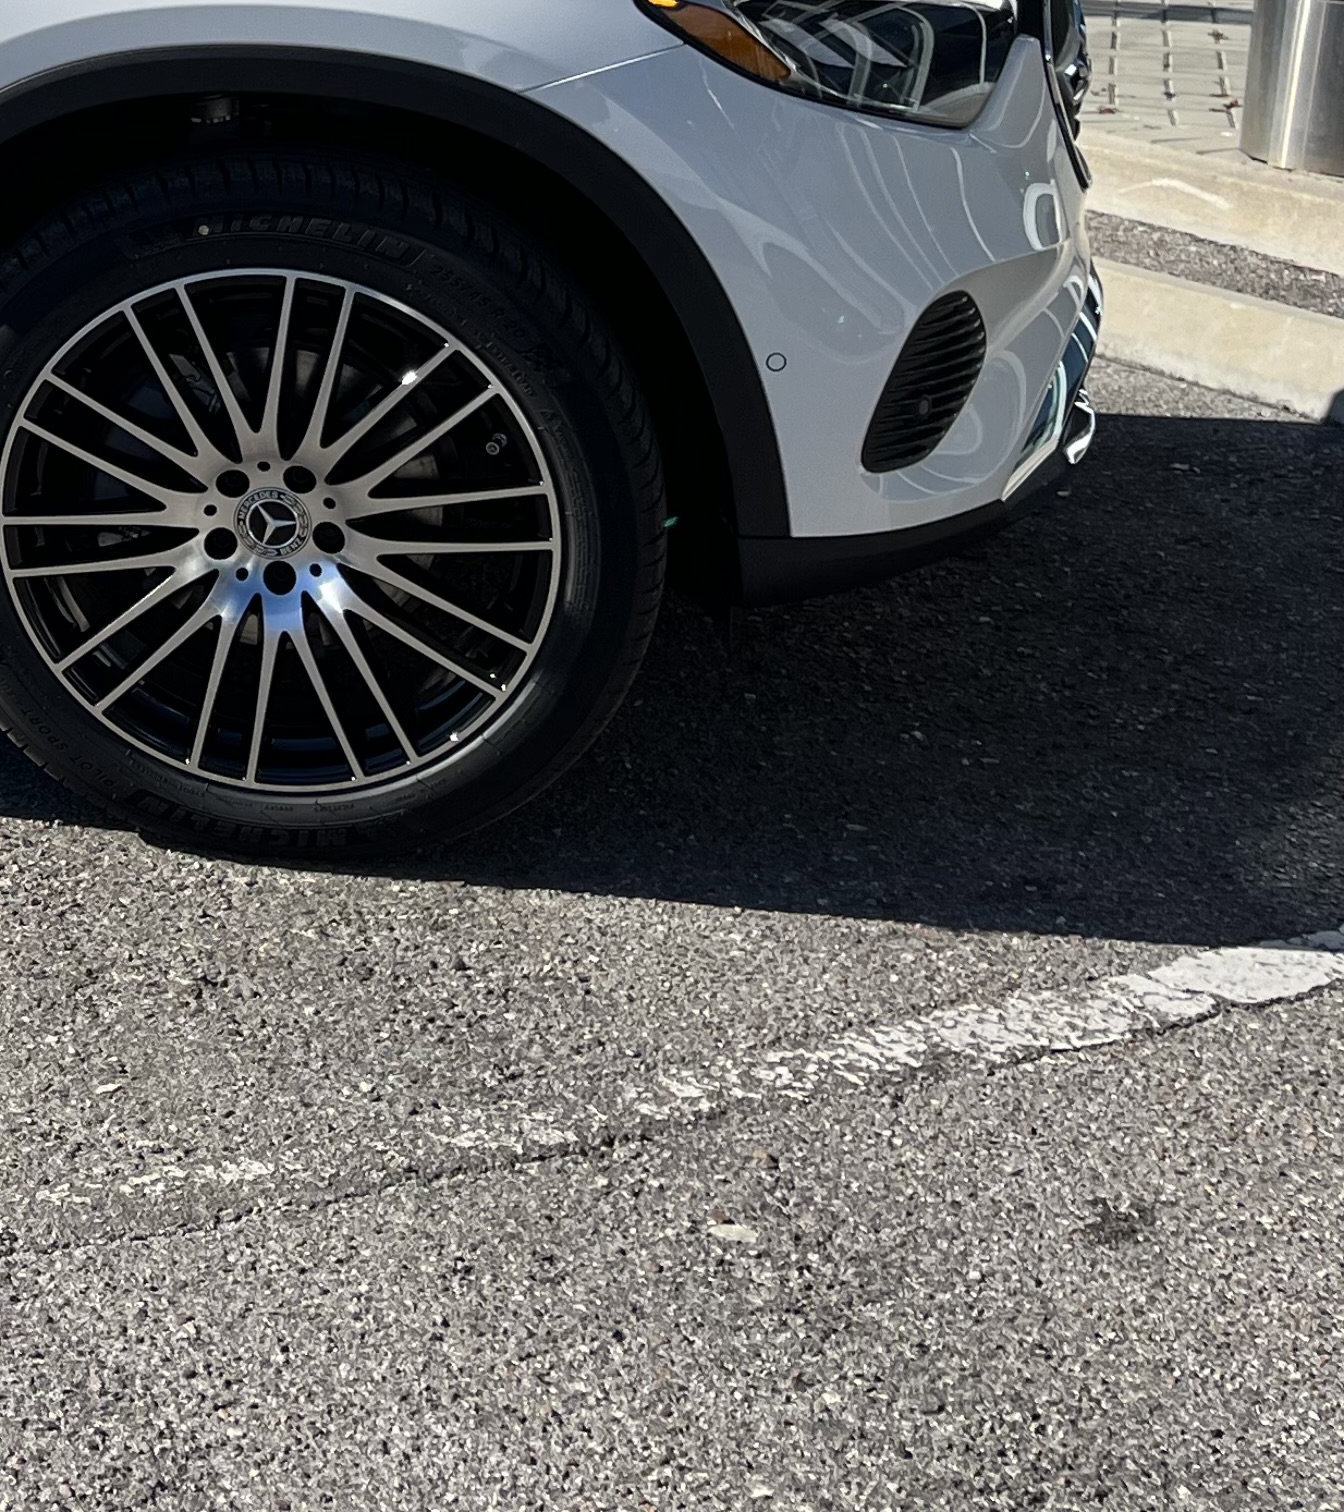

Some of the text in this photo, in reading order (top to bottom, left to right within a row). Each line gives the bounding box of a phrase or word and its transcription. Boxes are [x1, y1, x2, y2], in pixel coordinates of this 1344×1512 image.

[194, 214, 410, 261] MICHELIN
[238, 490, 279, 519] MERCEDES
[279, 537, 303, 556] BENZ
[20, 707, 69, 751] SPORT
[69, 754, 115, 787] PILOT
